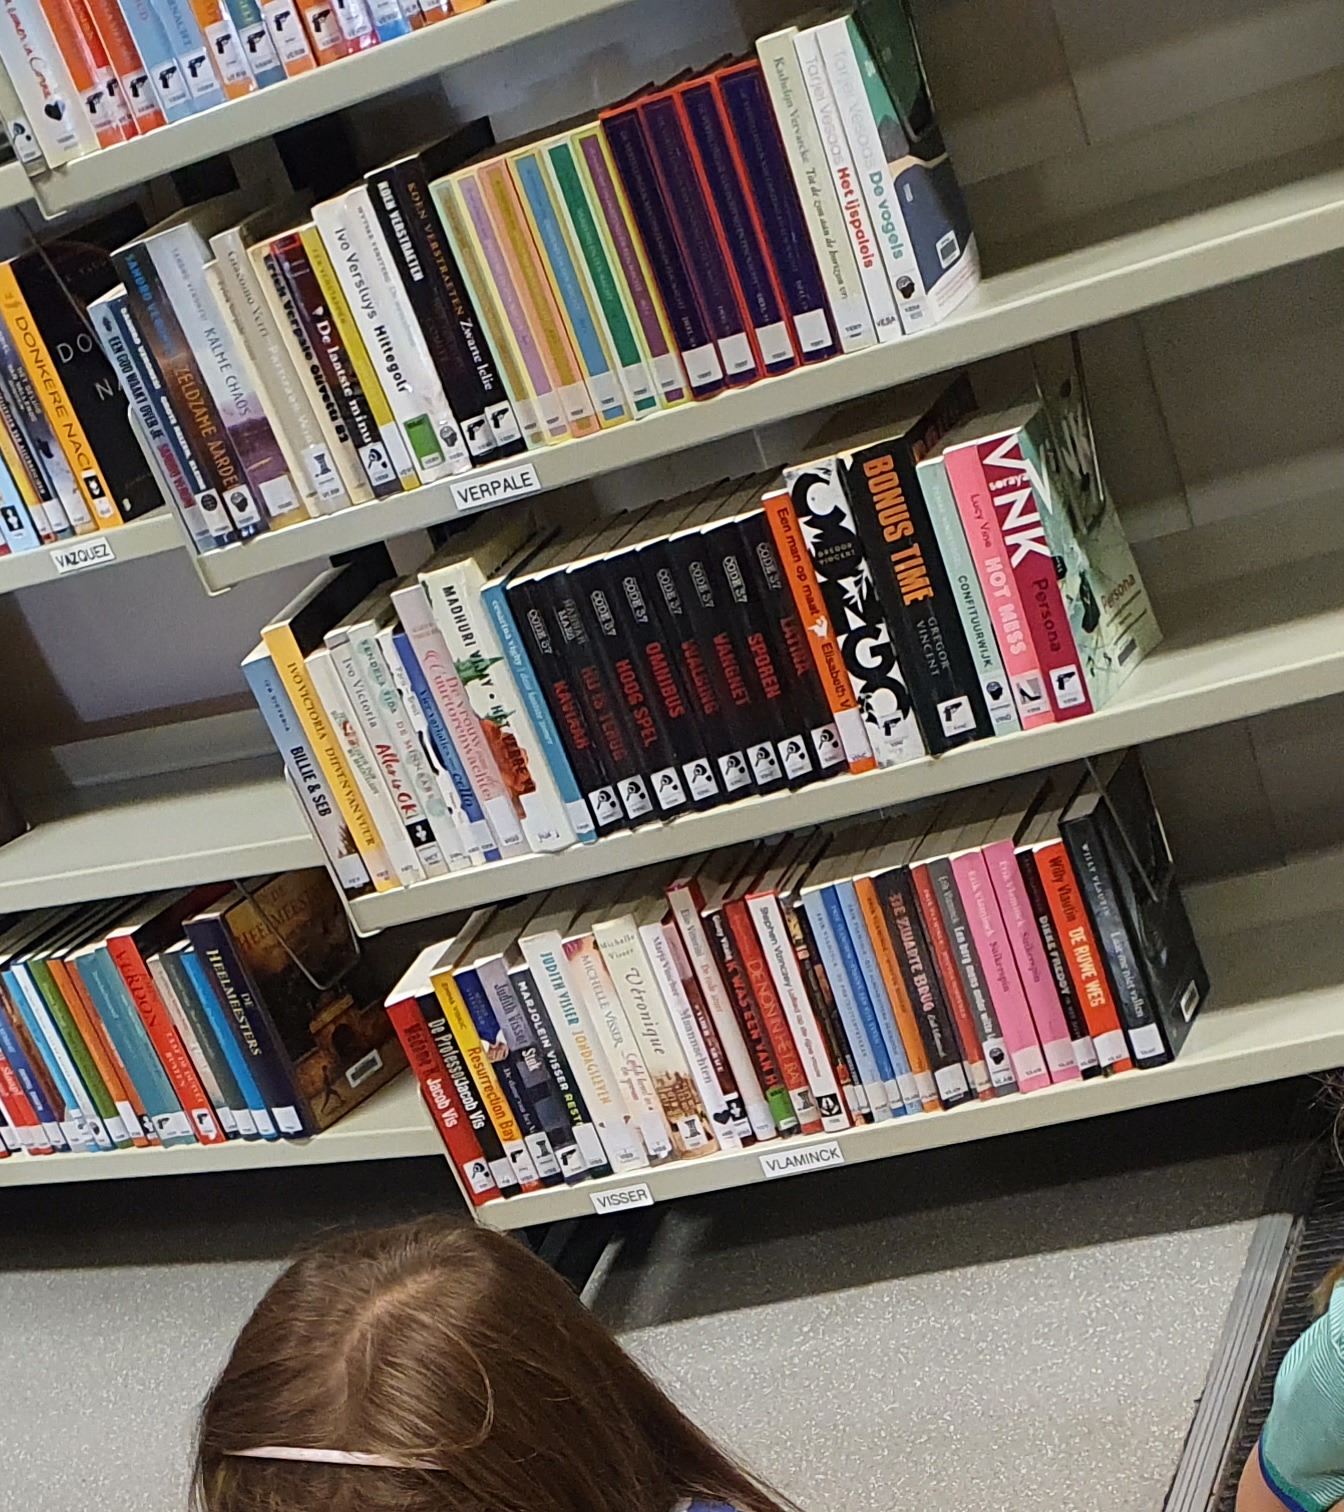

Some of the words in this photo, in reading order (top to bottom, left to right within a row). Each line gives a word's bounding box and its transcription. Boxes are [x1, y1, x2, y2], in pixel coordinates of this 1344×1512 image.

[773, 57, 793, 110] Kathelijn
[836, 167, 855, 197] Het
[869, 170, 885, 197] De
[878, 199, 905, 260] vogels
[335, 228, 351, 254] Ivo
[345, 252, 379, 320] Versluys
[407, 182, 426, 217] KOEN
[424, 218, 463, 316] VERSTRAETEN
[15, 315, 69, 422] DONKERE
[315, 320, 332, 345] De
[326, 345, 353, 404] laatste
[458, 318, 482, 362] Zwarte
[203, 327, 232, 376] KALME
[223, 375, 252, 416] CHAOS
[176, 366, 216, 439] ZELDZAME
[457, 472, 533, 503] VERPALE
[989, 471, 1030, 491] soraya
[777, 507, 792, 532] Een
[863, 454, 914, 543] BONUS
[890, 542, 935, 606] TIME
[55, 543, 112, 568] VAZQUEZ
[723, 556, 744, 588] CODE
[784, 534, 802, 563] man
[797, 564, 808, 586] op
[970, 493, 984, 521] Lucy
[985, 556, 1011, 600] HOT
[998, 603, 1027, 657] MESS
[623, 576, 644, 608] CODE
[656, 568, 677, 600] CODE
[801, 580, 821, 617] maat
[442, 585, 477, 648] MADHURI
[927, 616, 952, 670] GREGOR
[957, 574, 993, 667] CONFITUURWIJK
[1033, 578, 1061, 653] Persona
[747, 632, 782, 701] SPOREN
[821, 642, 848, 699] Elisabeth
[915, 620, 941, 677] VINCENT
[287, 661, 301, 682] IVO
[296, 680, 328, 742] VICTORIA
[343, 656, 357, 678] Ivo
[354, 678, 377, 729] Victoria
[645, 642, 686, 718] OMNIBUS
[290, 744, 311, 786] BILLIE
[307, 783, 318, 796] &
[453, 772, 474, 808] cello
[312, 793, 333, 818] SEB
[1048, 856, 1065, 884] Willy
[759, 906, 778, 946] Stephen
[774, 945, 792, 989] Vizinczey
[1068, 926, 1085, 945] DE
[1074, 946, 1097, 981] RUWE
[115, 949, 157, 1027] VERDON
[540, 952, 564, 991] JUDITH
[558, 992, 580, 1026] VISSER
[747, 960, 764, 978] DE
[1049, 951, 1071, 996] FREDDY
[1085, 980, 1106, 1008] WEG
[206, 949, 262, 1056] HEELMEESTERS
[241, 992, 254, 1008] DE
[494, 983, 515, 1016] Judith
[507, 1015, 529, 1045] Visser
[582, 955, 610, 1009] MICHELLE
[604, 1010, 624, 1048] VISSER
[625, 967, 665, 1055] Véronique
[731, 975, 747, 1008] WAS
[744, 1009, 761, 1039] EEN
[757, 1041, 773, 1072] VAN
[517, 981, 552, 1048] MARJOLEIN
[546, 1049, 568, 1091] VISSER
[427, 1077, 448, 1110] Jacob
[442, 1108, 458, 1128] Vis
[428, 1018, 445, 1034] De
[455, 1081, 474, 1112] Jacob
[469, 1110, 485, 1130] Vis
[468, 1047, 506, 1120] Resurrection
[499, 1120, 515, 1142] Bay
[766, 1148, 840, 1171] VLAMINCK
[597, 1188, 648, 1208] VISSER
